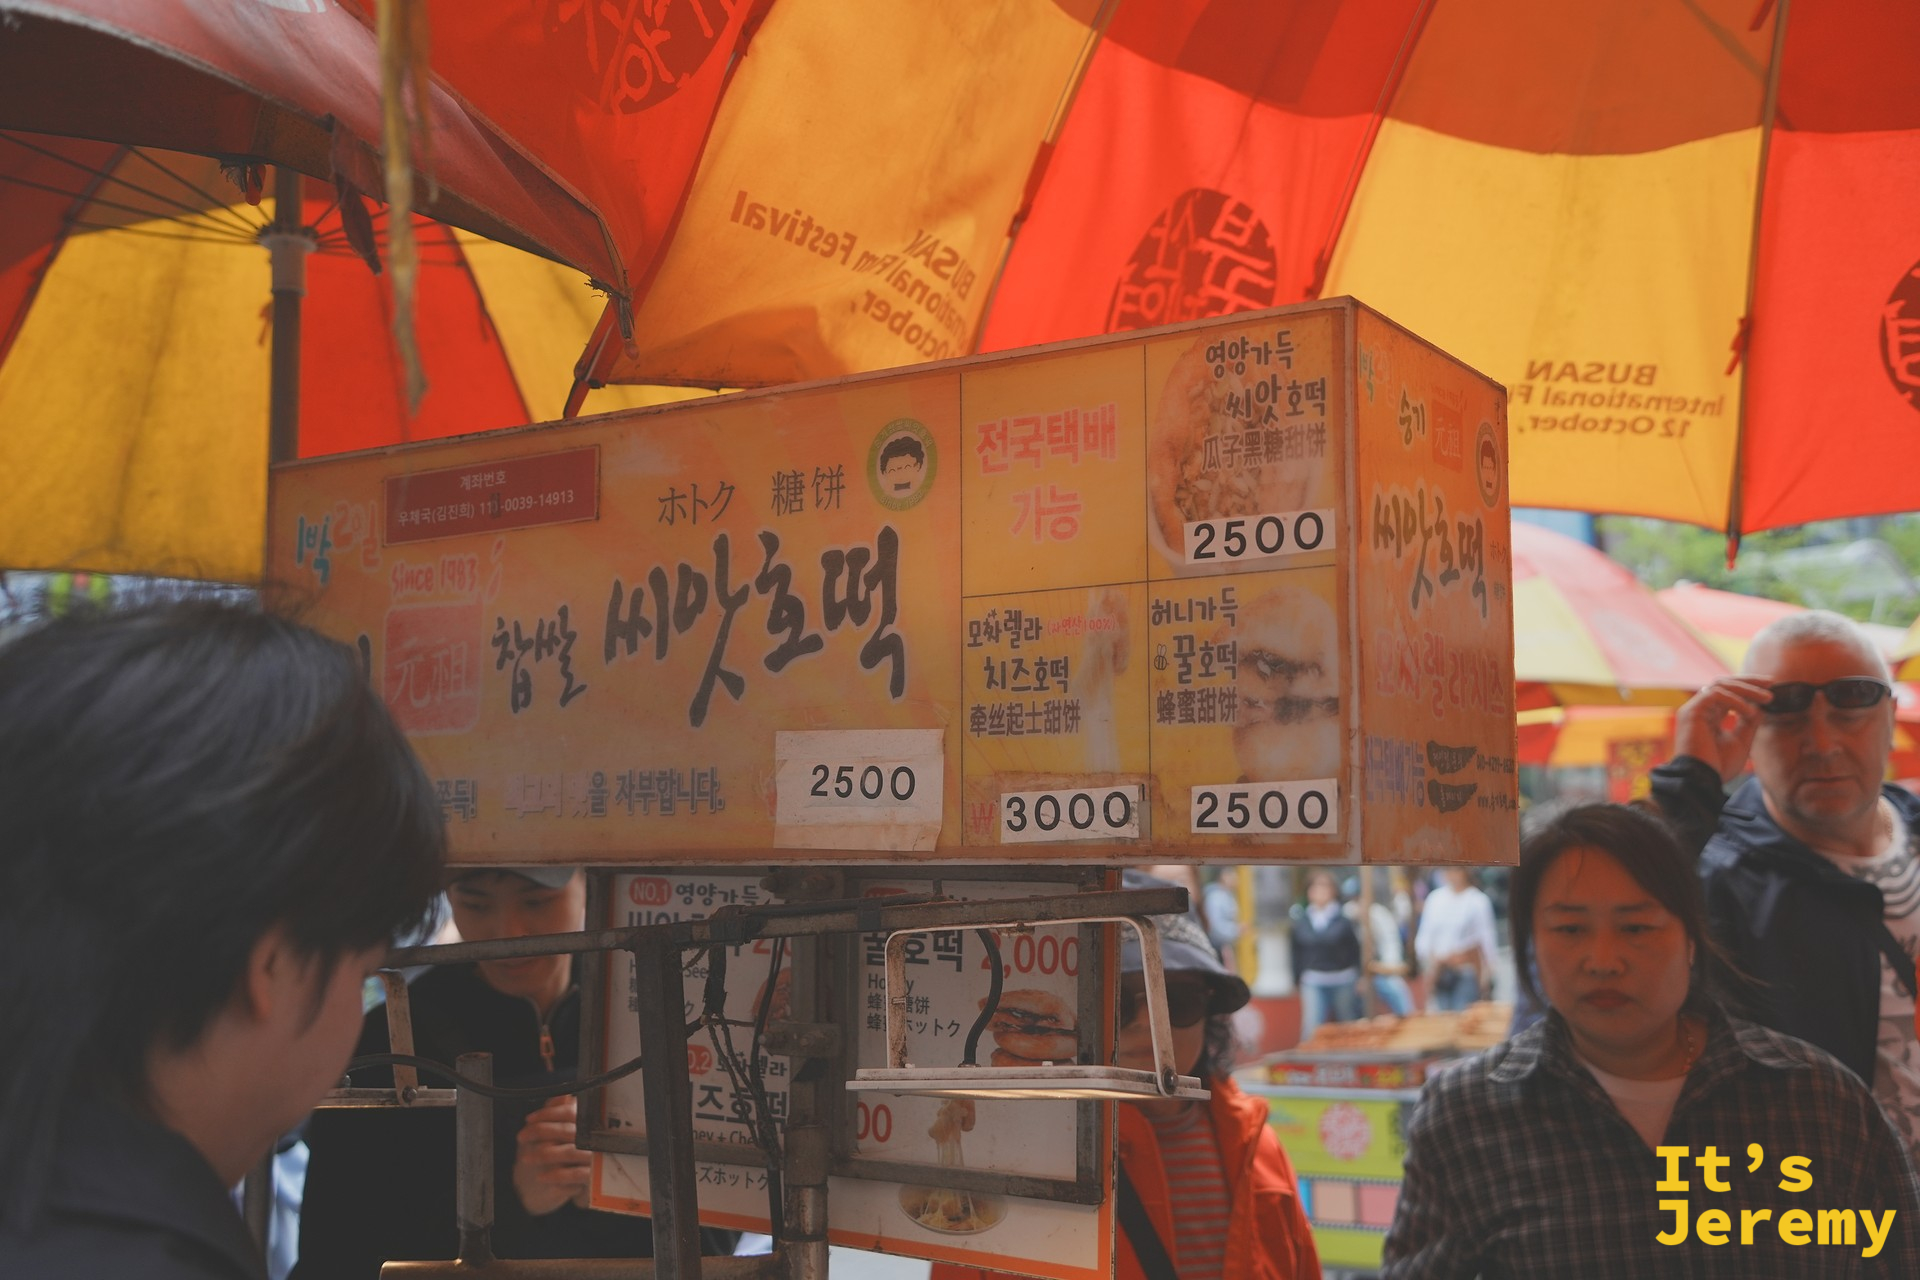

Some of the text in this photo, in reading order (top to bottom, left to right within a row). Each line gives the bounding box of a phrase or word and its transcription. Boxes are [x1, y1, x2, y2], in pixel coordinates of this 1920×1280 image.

[1205, 330, 1295, 379] 영양가득
[975, 403, 1117, 474] 전국택배
[1399, 388, 1426, 446] 승기
[459, 469, 507, 492] 계좌번호
[771, 463, 846, 518] 糖饼
[657, 481, 736, 527] ホトク
[1009, 484, 1083, 543] 가능
[1193, 511, 1325, 560] 2500
[1373, 487, 1488, 619] 씨앗호떡
[491, 525, 906, 728] 찹쌀 씨앗호떡
[1151, 586, 1238, 627] 허니가득
[967, 609, 1043, 649] 모짜렐라
[983, 655, 1070, 693] 치즈호떡
[1173, 634, 1238, 685] 꿀호떡
[968, 698, 1081, 738] 牵丝起士甜饼
[1156, 687, 1238, 725] 蜂蜜甜饼
[614, 766, 727, 817] 자부합니다.
[810, 764, 917, 801] 2500
[1006, 791, 1131, 832] 3000
[1196, 790, 1329, 830] 2500
[633, 881, 669, 903] NO.1
[675, 882, 760, 907] 영양가득
